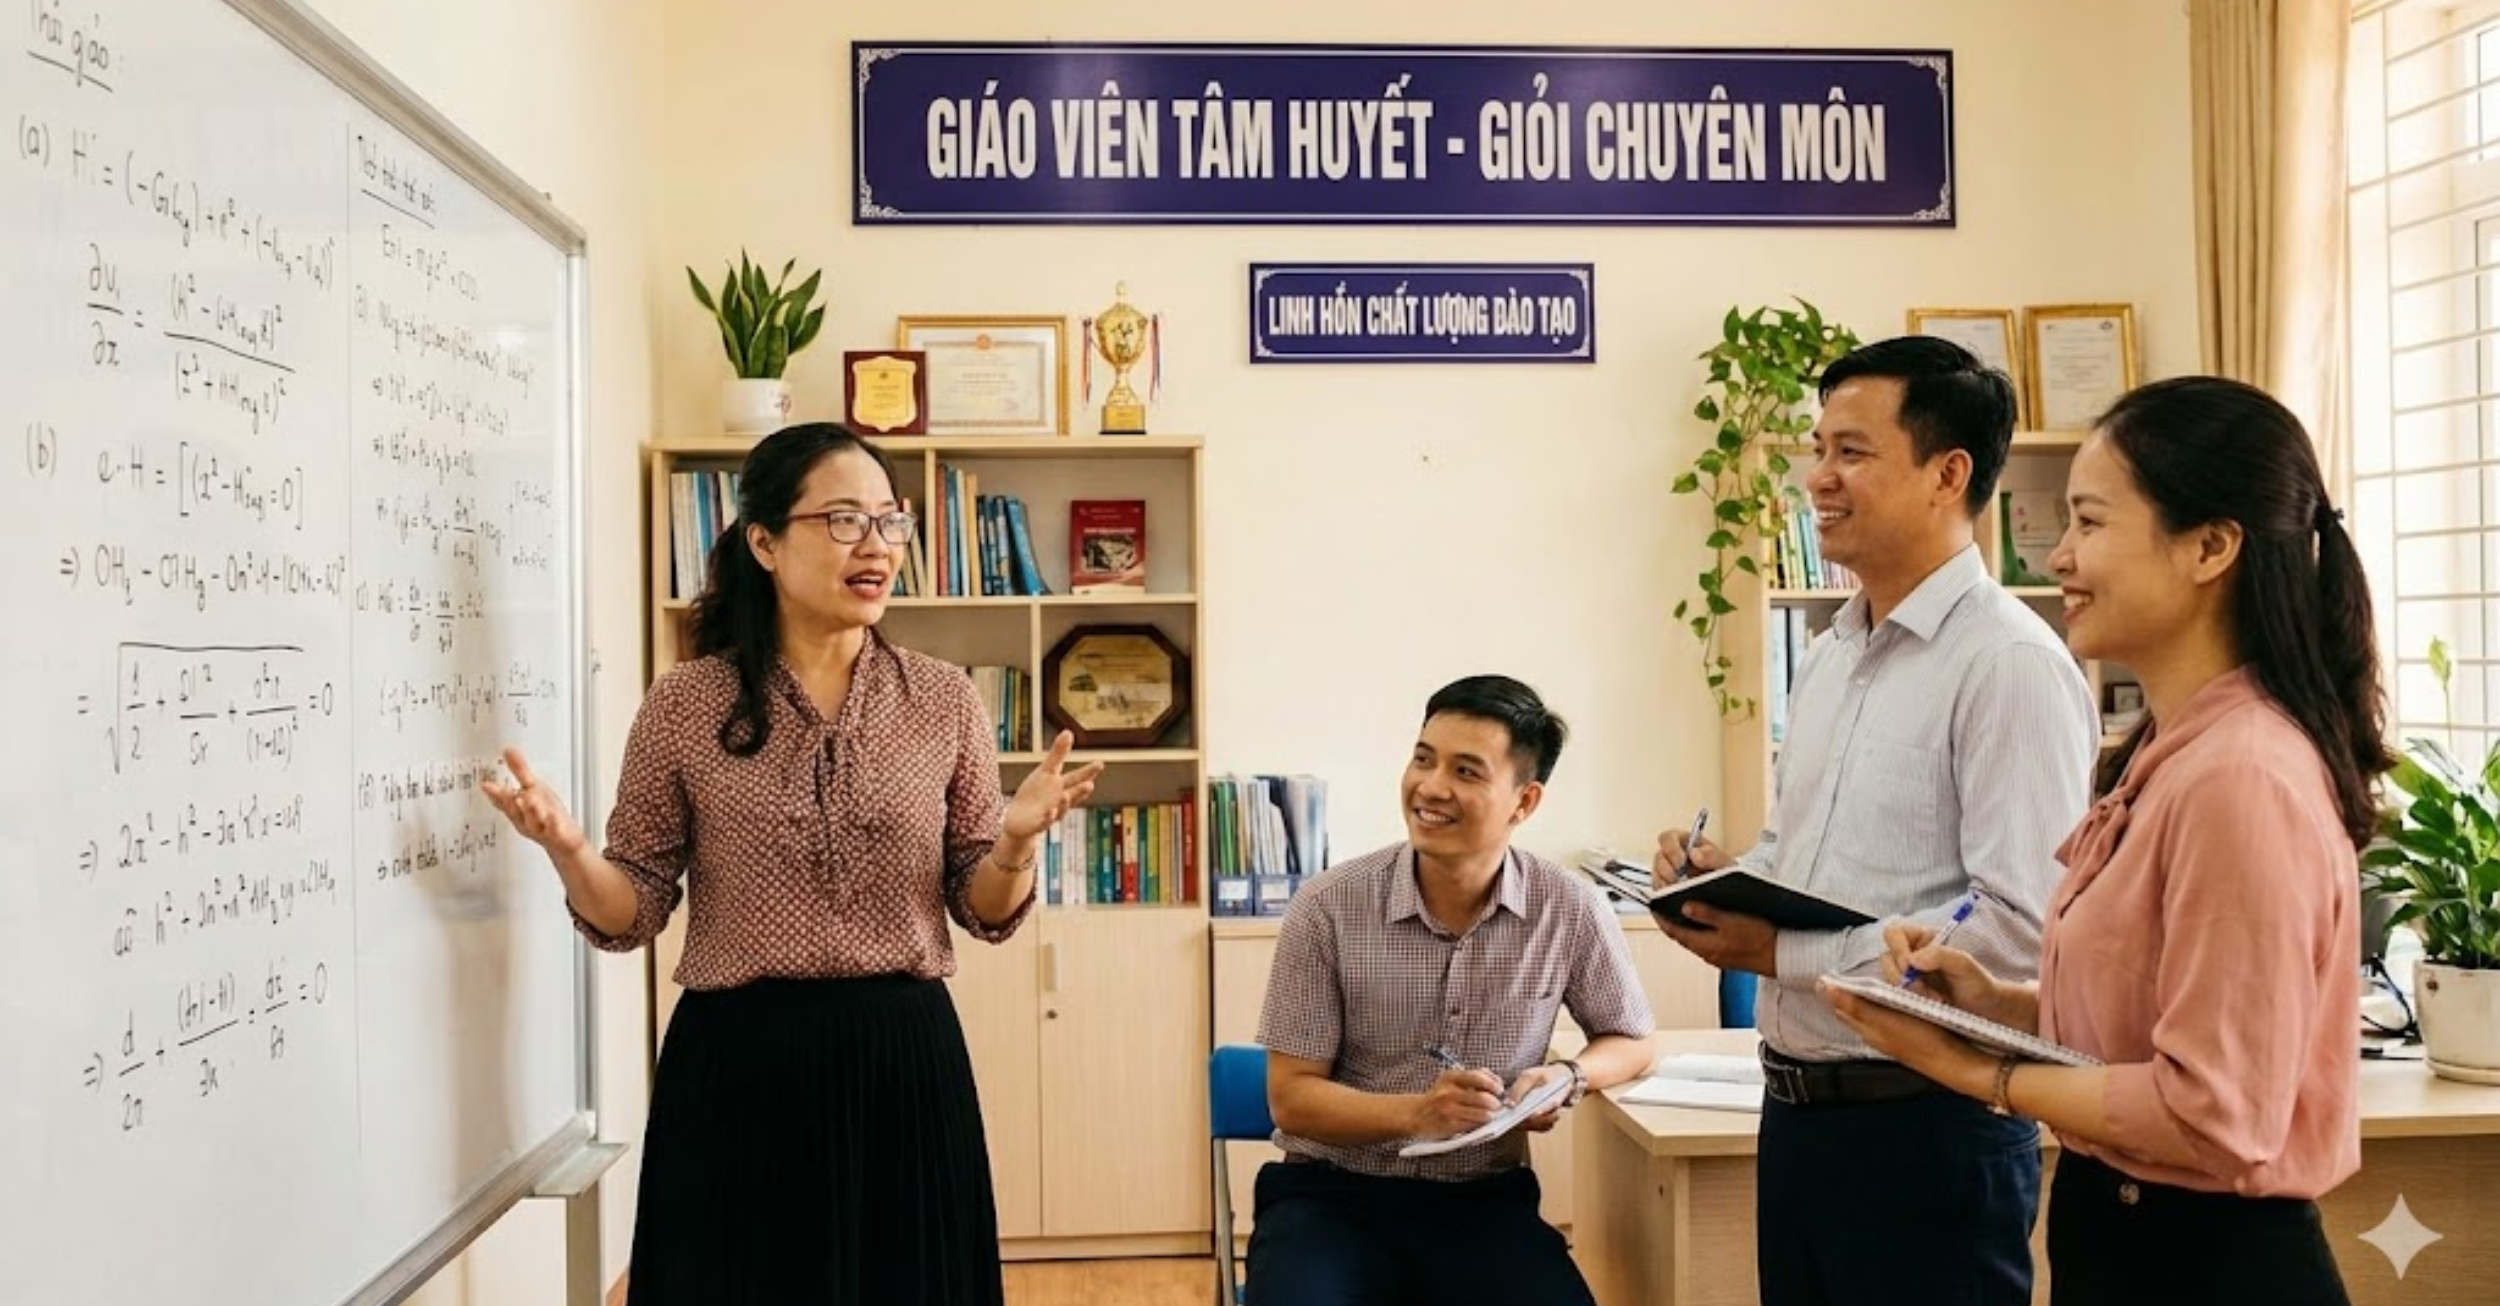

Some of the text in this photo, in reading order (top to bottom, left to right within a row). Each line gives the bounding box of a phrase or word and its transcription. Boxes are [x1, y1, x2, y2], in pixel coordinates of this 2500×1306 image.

[927, 81, 1036, 179] GIÁO
[1051, 81, 1159, 178] VIÊN
[1172, 81, 1273, 179] TÂM
[1289, 74, 1433, 180] HUYẾT
[1479, 73, 1571, 181] GIỎI
[1585, 85, 1766, 181] CHUYÊN
[1781, 87, 1885, 182] MÔN
[1268, 295, 1315, 335] LINH
[1367, 281, 1419, 336] CHẤT
[1423, 291, 1490, 345] LƯỢNG
[1537, 295, 1577, 345] TẠO
